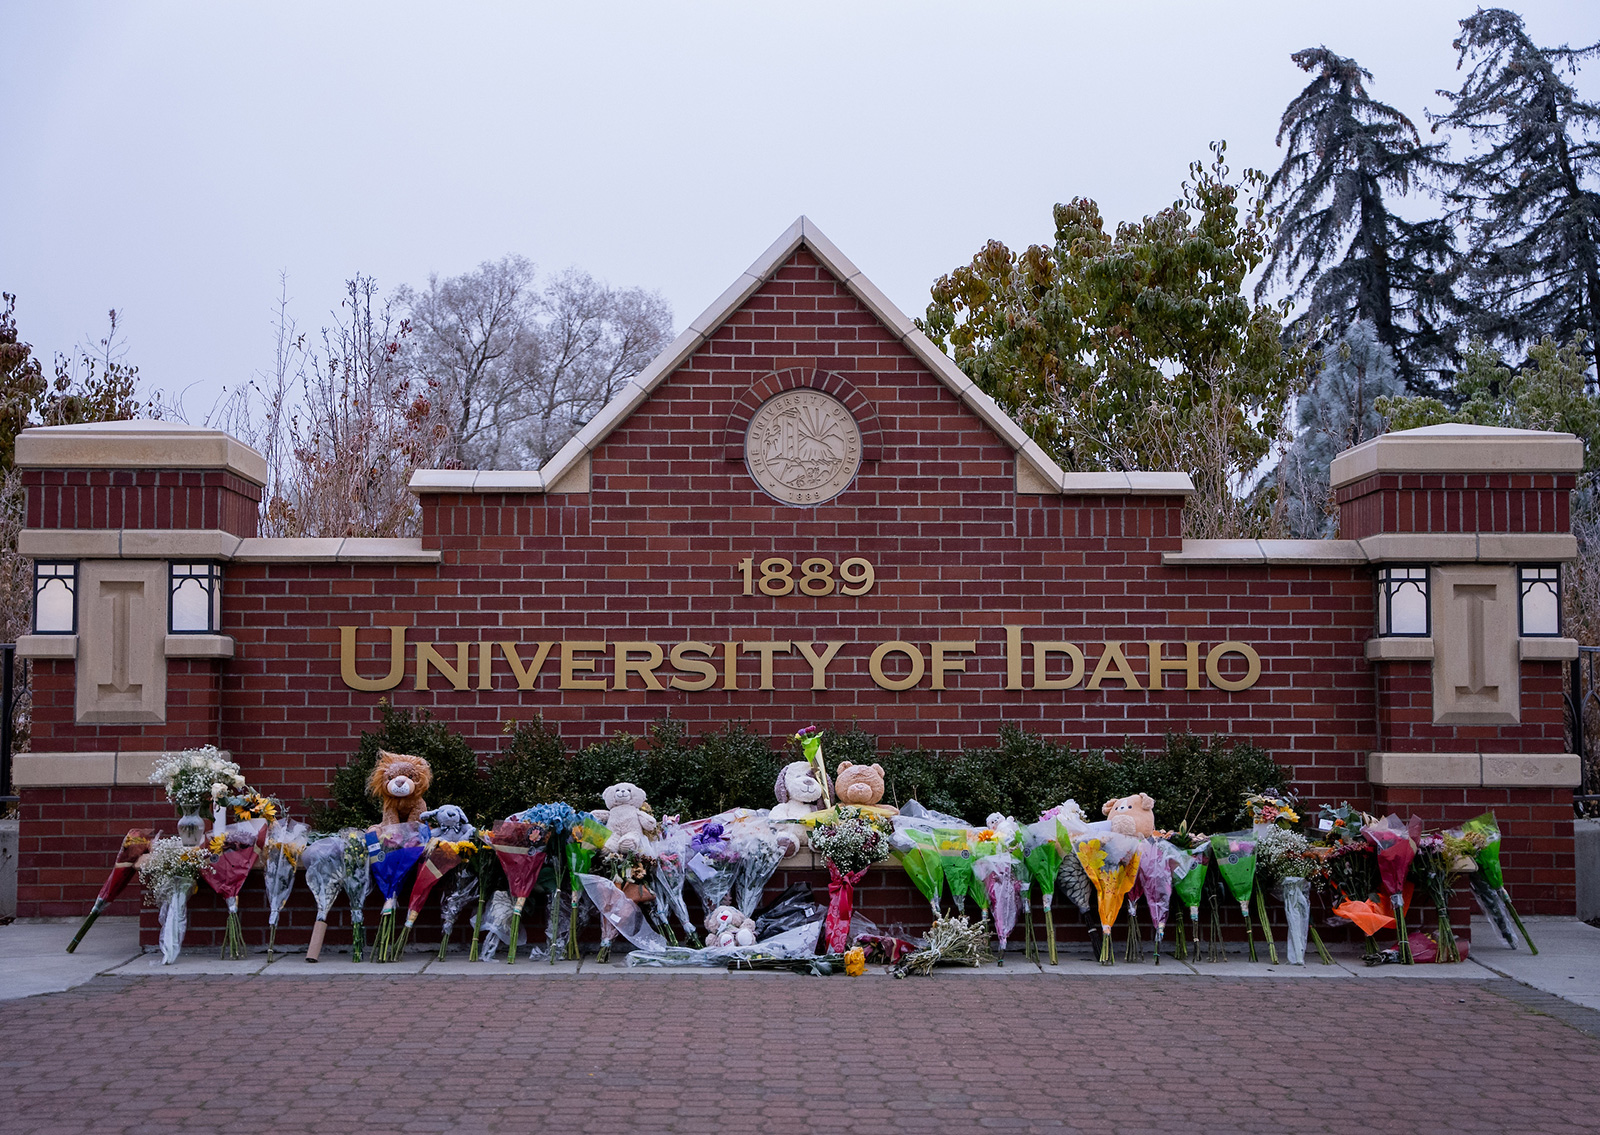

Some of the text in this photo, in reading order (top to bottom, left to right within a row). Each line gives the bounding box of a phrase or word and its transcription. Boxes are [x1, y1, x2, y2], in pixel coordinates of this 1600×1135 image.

[751, 395, 857, 475] THE UNIVERSITY OF IDAHO
[738, 557, 876, 597] 1889
[338, 625, 1262, 692] UNIVERSITY OF IDAHO
